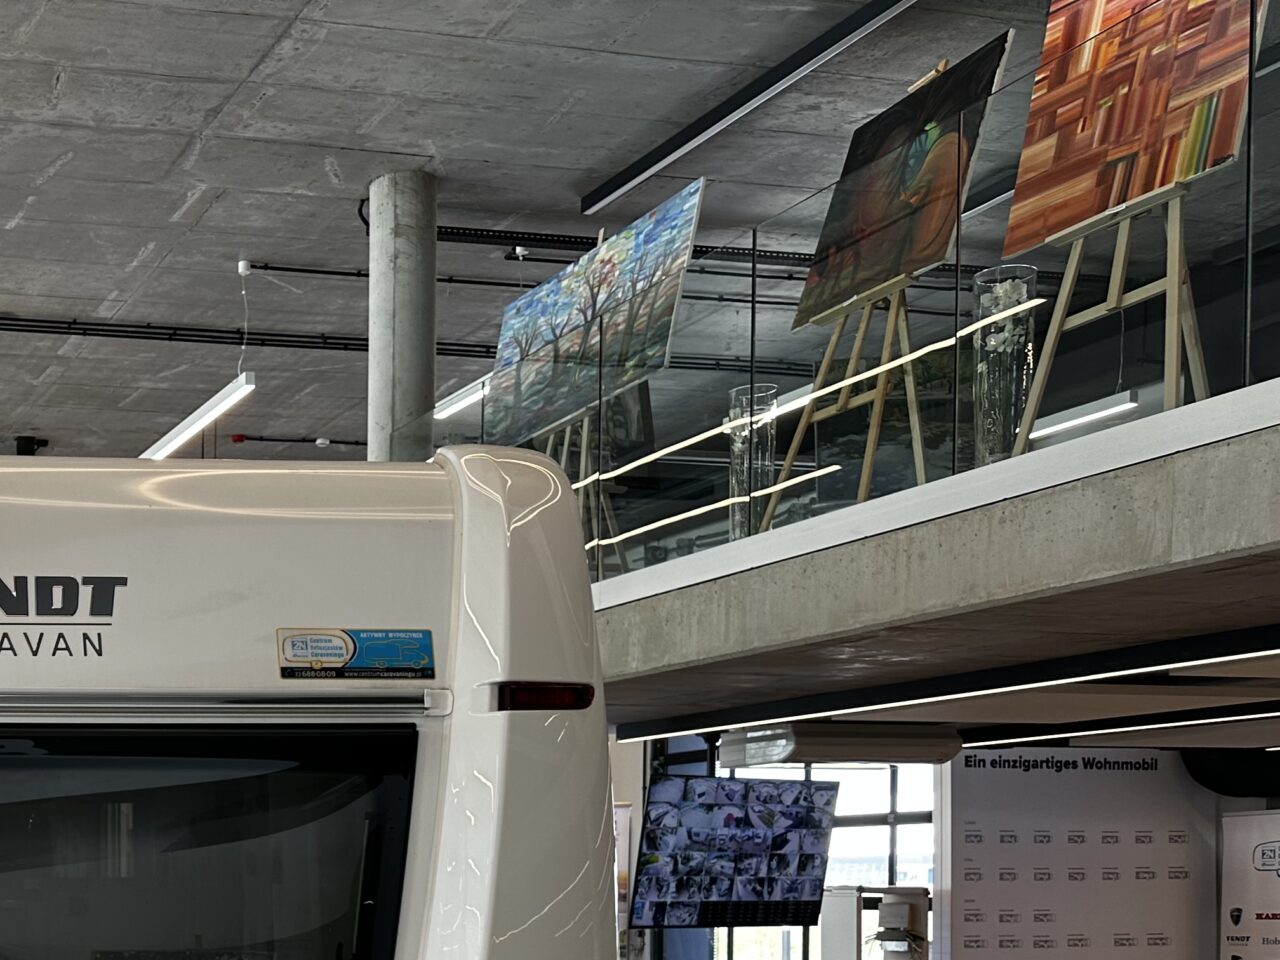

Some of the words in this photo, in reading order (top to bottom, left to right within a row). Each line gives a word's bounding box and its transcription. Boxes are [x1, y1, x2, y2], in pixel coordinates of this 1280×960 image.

[291, 640, 308, 651] 2N
[964, 755, 986, 769] Ein
[990, 755, 1078, 773] einzigartiges
[1082, 757, 1158, 771] Wohnmobil
